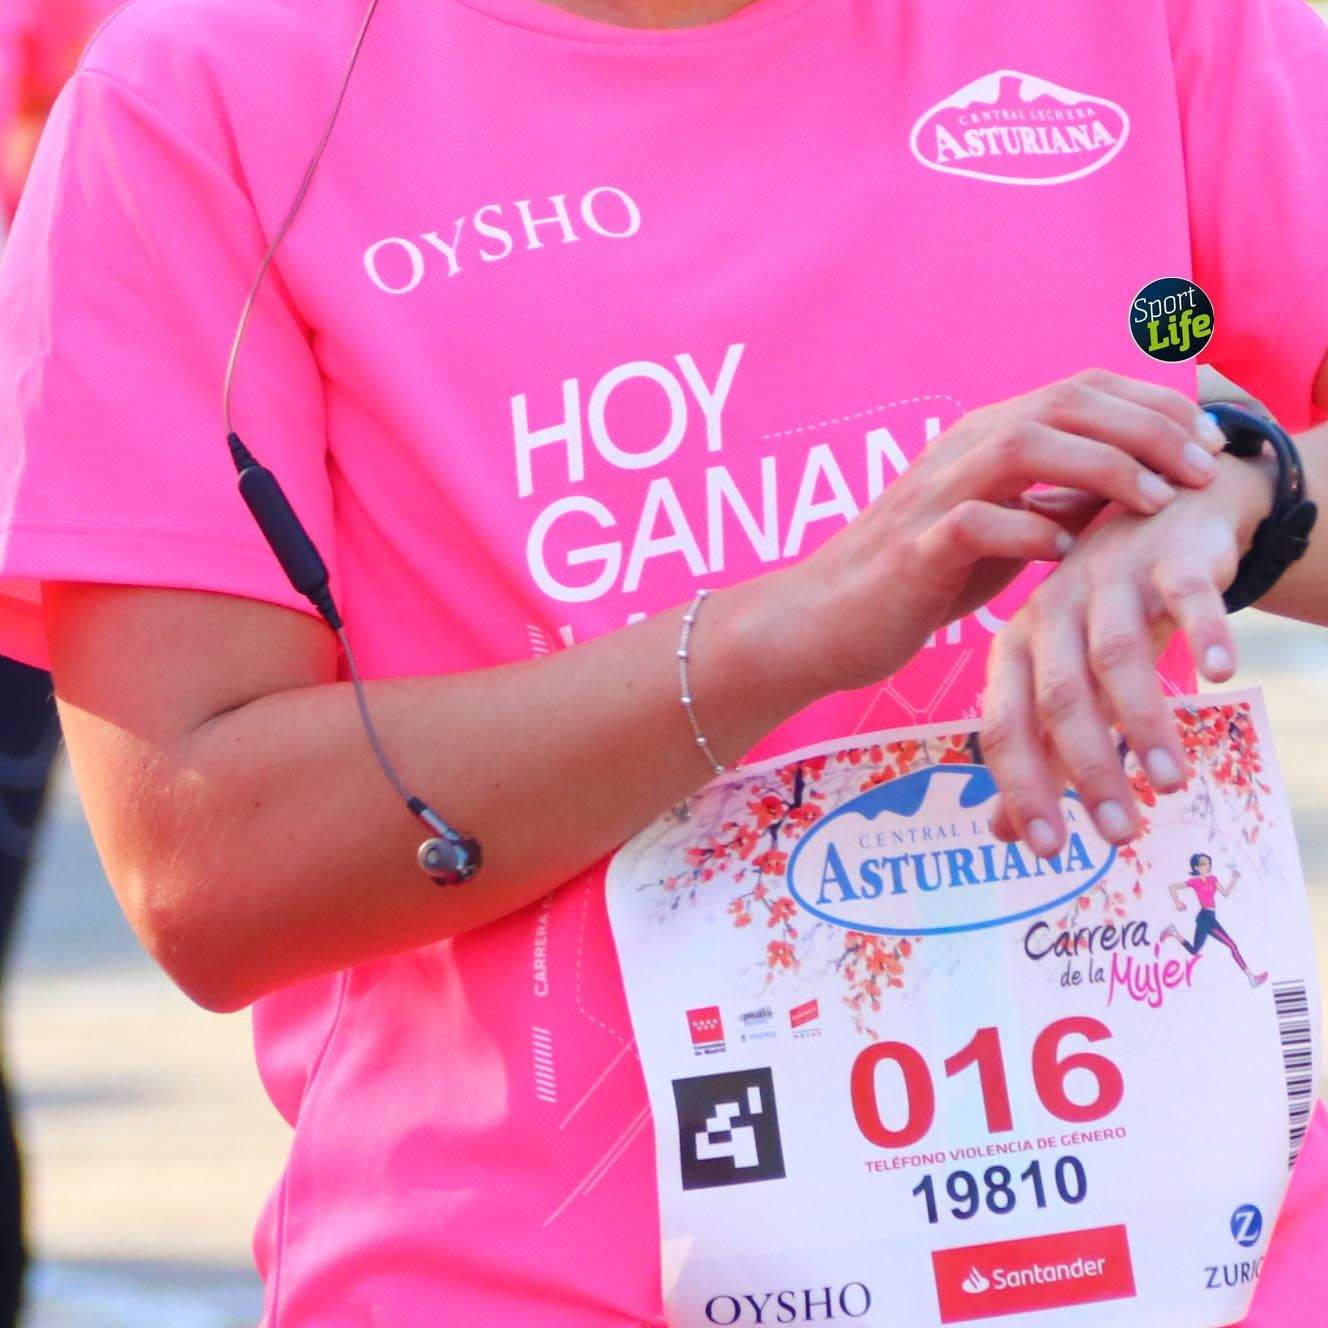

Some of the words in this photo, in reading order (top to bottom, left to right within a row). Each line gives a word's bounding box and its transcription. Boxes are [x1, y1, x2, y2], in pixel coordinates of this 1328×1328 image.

[935, 120, 1117, 163] ASTURIANA
[363, 185, 641, 295] OYSHO
[511, 343, 745, 498] HOY
[858, 822, 961, 850] CENTRAL
[1024, 920, 1150, 960] Carrera
[1060, 960, 1083, 987] de
[1089, 957, 1106, 983] la
[1107, 943, 1203, 1008] Mujer
[850, 1016, 1124, 1149] 016
[865, 1151, 946, 1173] TELÉFONO
[949, 1140, 1033, 1162] VIOLENCIA
[1037, 1135, 1056, 1150] DE
[1060, 1126, 1126, 1147] GÉNERO
[912, 1155, 1087, 1224] 19810
[993, 1256, 1106, 1290] Santander
[705, 1282, 871, 1326] OYSHO
